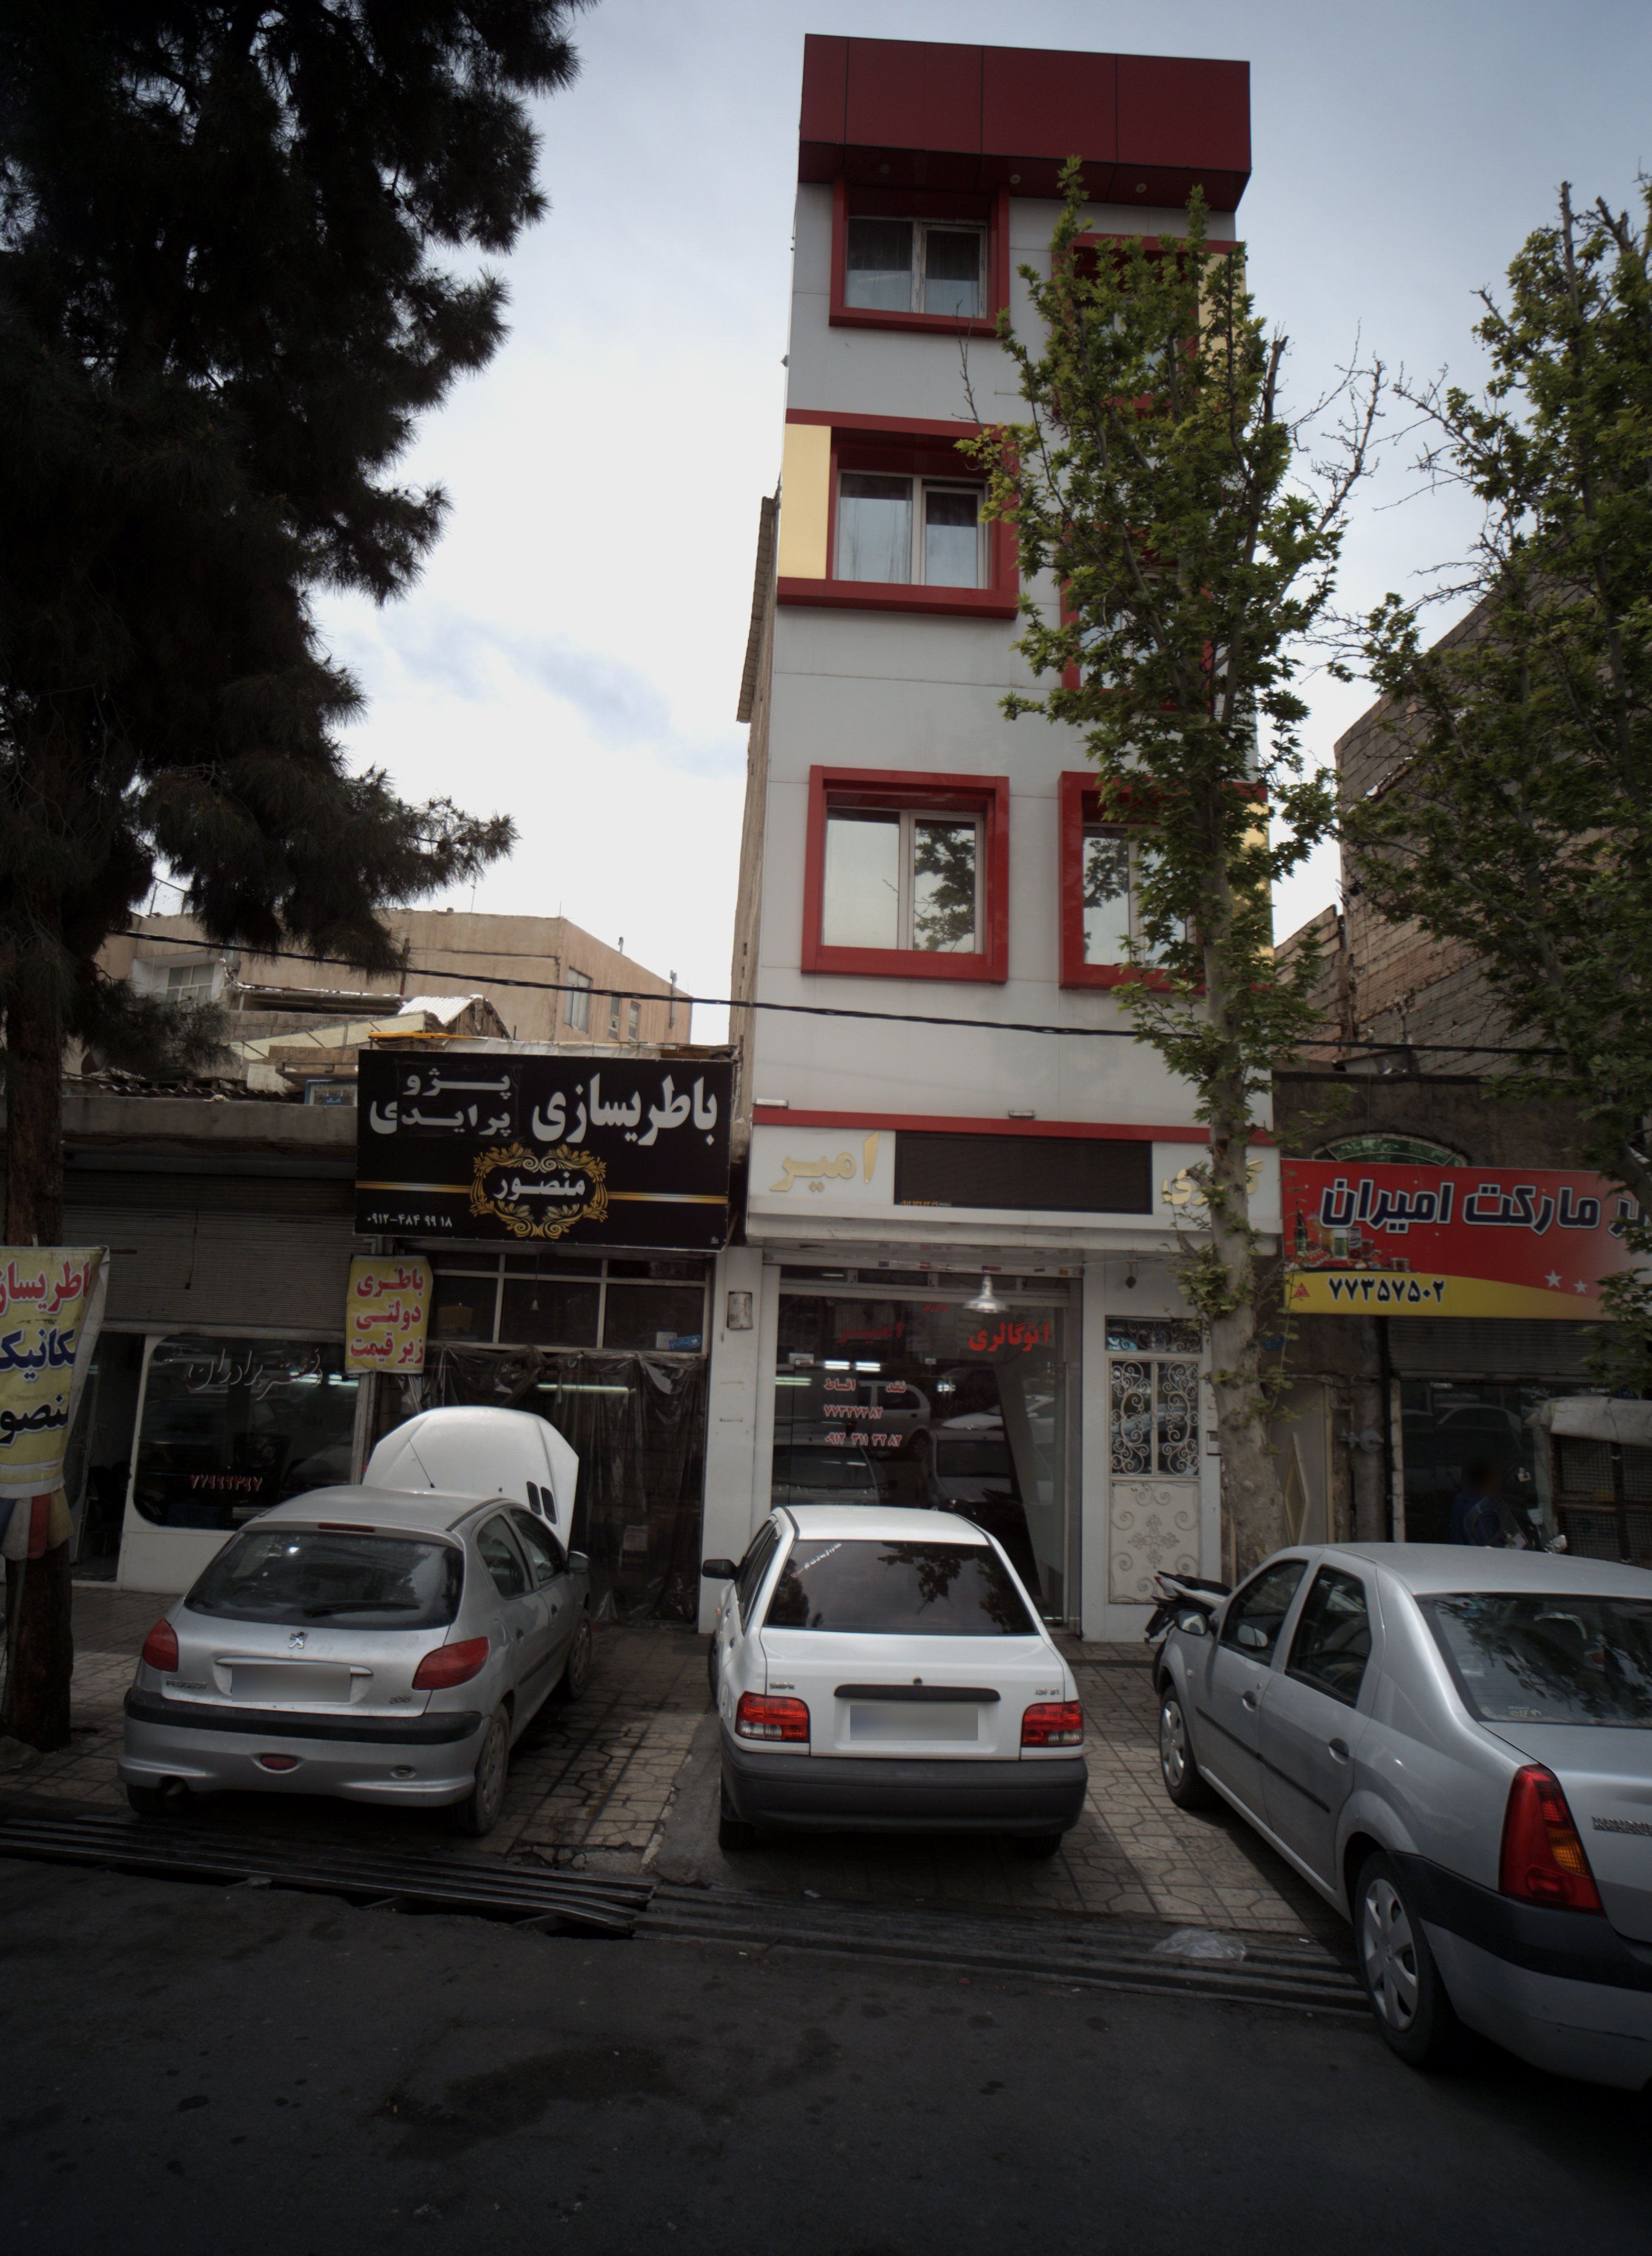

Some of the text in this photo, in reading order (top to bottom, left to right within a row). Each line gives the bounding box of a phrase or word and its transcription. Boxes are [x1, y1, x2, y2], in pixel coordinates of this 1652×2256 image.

[403, 1067, 512, 1100] پژو
[532, 1072, 716, 1146] باطریسازی
[770, 1131, 878, 1192] امیر
[494, 1172, 585, 1200] منصور
[1320, 1178, 1455, 1234] امیران
[1462, 1184, 1601, 1235] مارکت
[357, 1267, 423, 1297] باطری
[1328, 1277, 1445, 1303] ۷۷۳۵۷۵۰۲
[356, 1300, 421, 1331] دولتی
[835, 1319, 904, 1344] امیر
[350, 1332, 423, 1364] زیر قیمت
[824, 1378, 906, 1393] نقد اقساط
